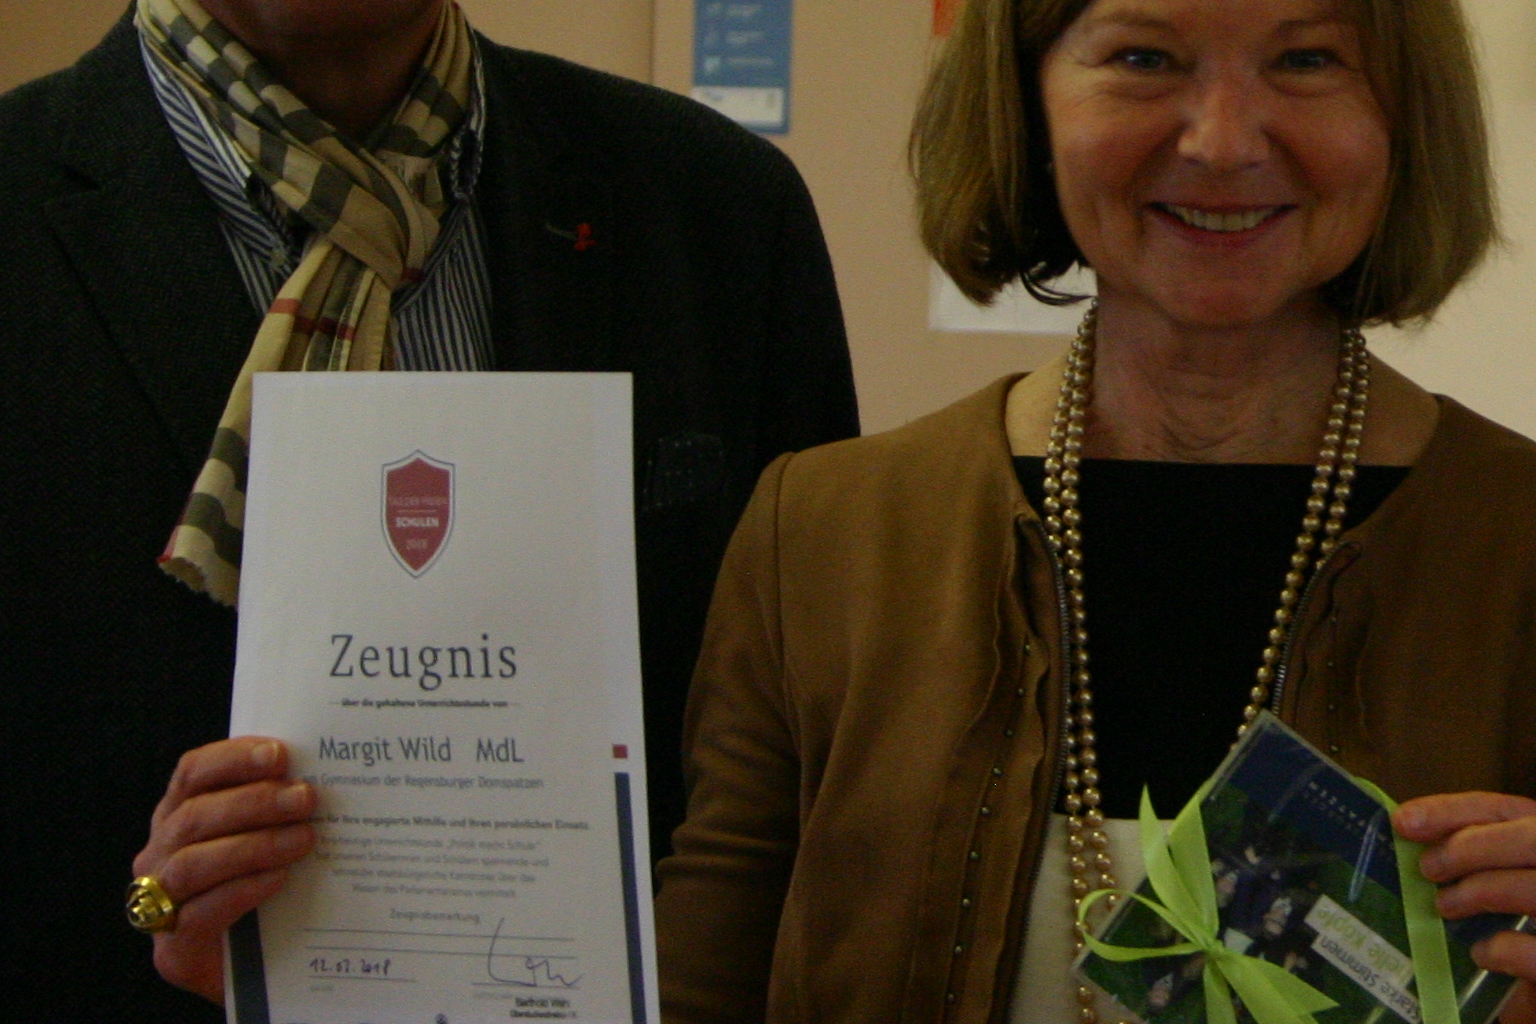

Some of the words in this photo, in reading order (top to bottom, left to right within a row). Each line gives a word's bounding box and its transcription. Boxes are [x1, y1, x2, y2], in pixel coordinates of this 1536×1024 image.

[330, 633, 517, 691] Zeugnis
[319, 736, 393, 766] Margit
[398, 737, 451, 763] Wild
[476, 738, 525, 763] MdL
